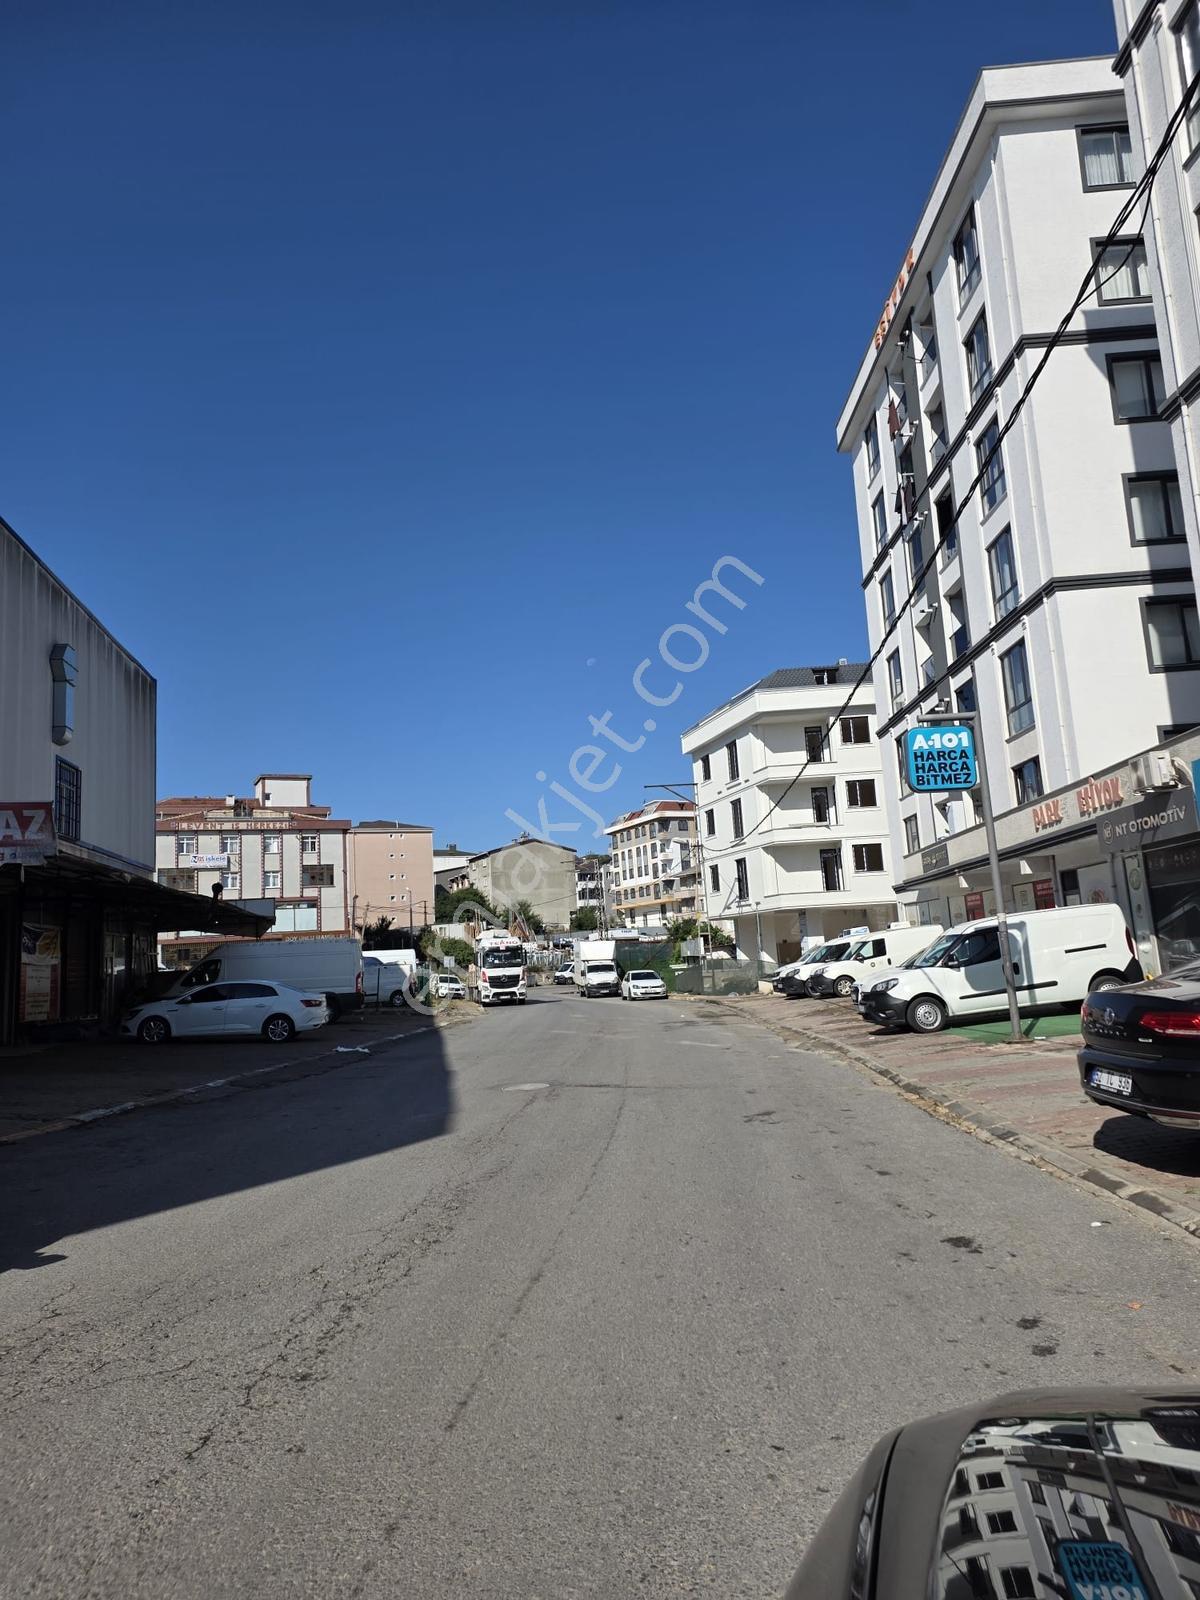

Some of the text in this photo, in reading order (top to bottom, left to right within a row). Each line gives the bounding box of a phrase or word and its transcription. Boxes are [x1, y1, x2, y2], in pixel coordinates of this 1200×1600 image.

[913, 749, 970, 762] HARCA
[915, 761, 971, 774] HARCA
[1033, 800, 1064, 831] PARK
[1115, 823, 1128, 837] NT
